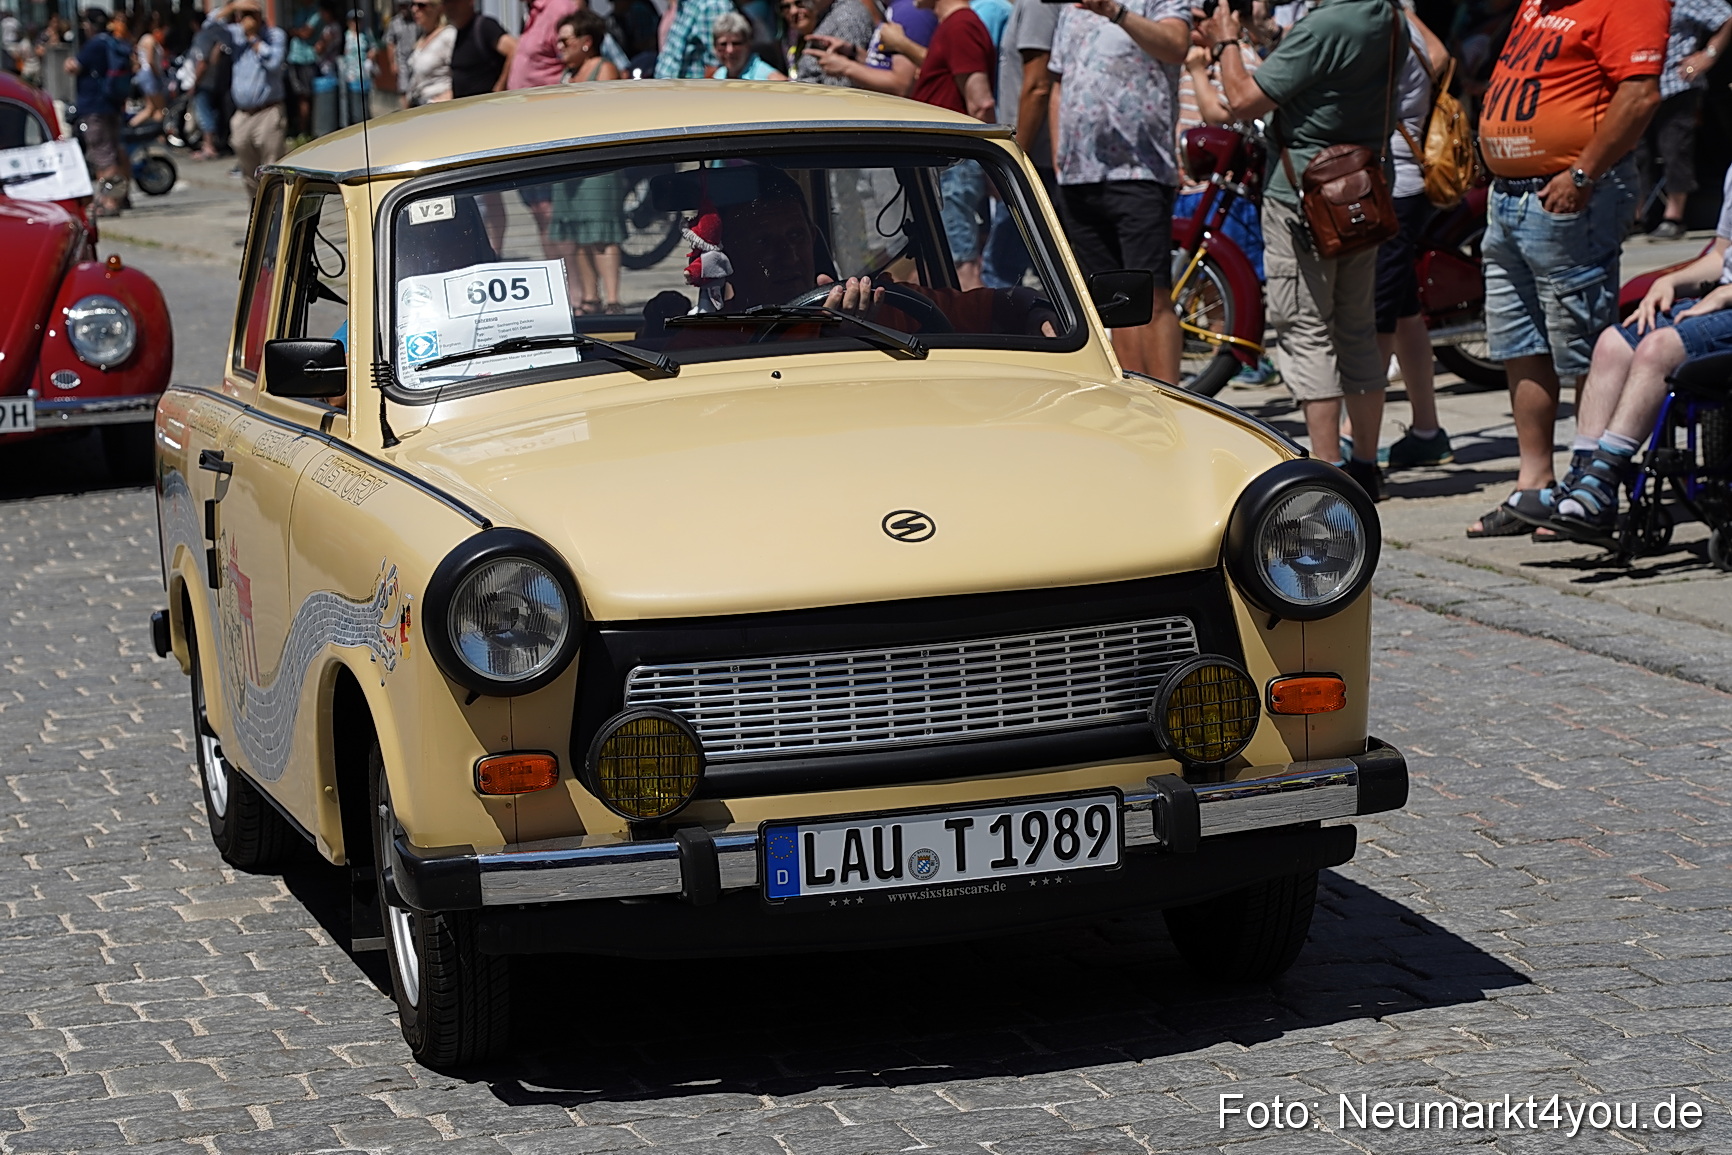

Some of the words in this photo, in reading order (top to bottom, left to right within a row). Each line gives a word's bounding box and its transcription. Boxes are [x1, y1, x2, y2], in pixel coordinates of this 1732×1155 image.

[467, 277, 530, 305] 605
[252, 429, 309, 469] GERMAN
[311, 454, 389, 506] HISTORY
[803, 825, 904, 887] LAU
[945, 817, 974, 872] T
[989, 804, 1112, 869] 1989
[777, 869, 789, 885] D
[887, 881, 1007, 903] www.sixstarscars.de
